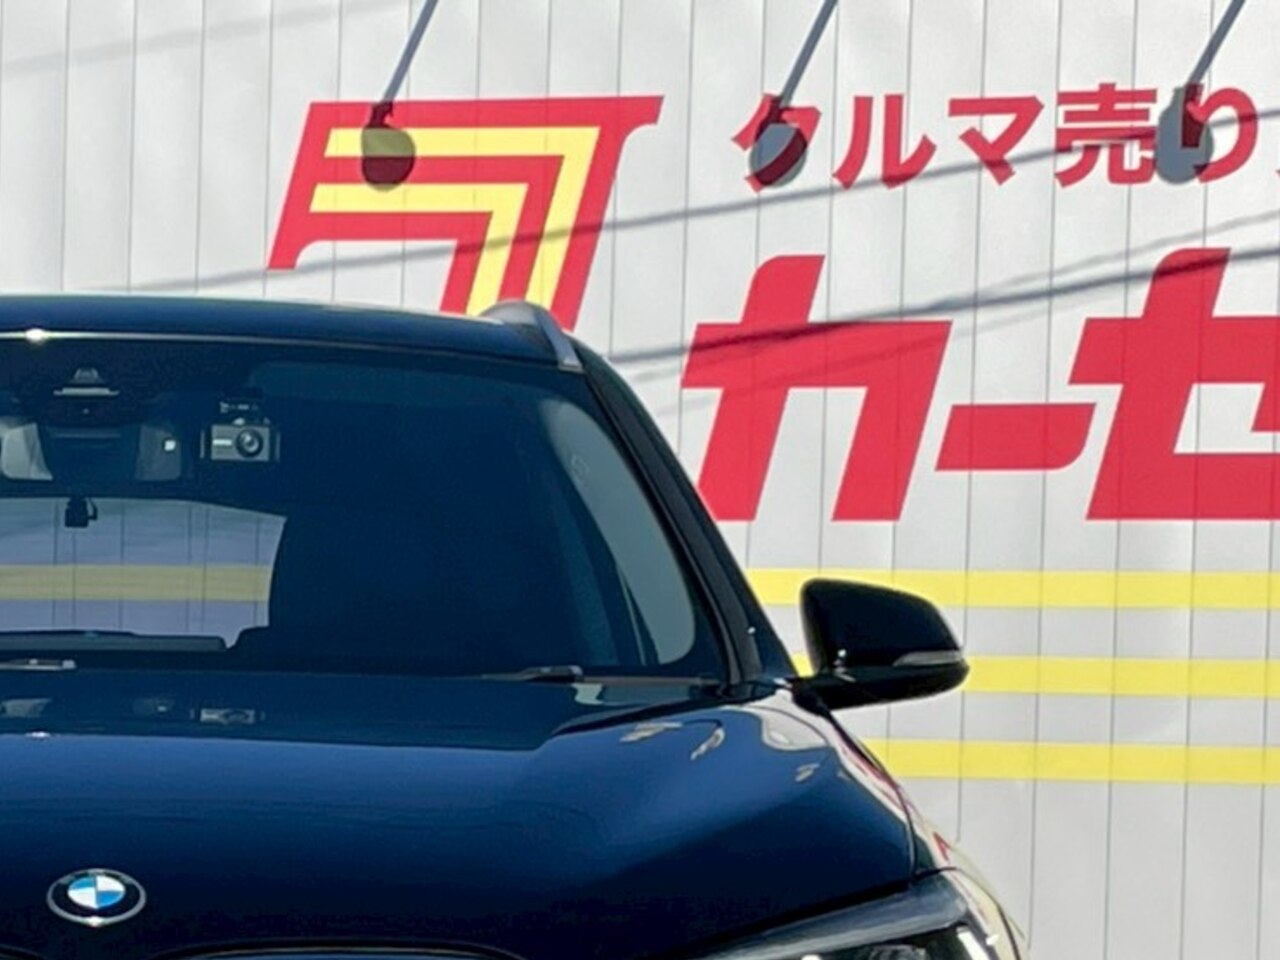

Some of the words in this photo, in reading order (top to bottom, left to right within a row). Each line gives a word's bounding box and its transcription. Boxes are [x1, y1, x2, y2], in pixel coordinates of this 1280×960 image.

[731, 83, 1259, 192] クルマ売り
[681, 247, 1280, 523] カーセ
